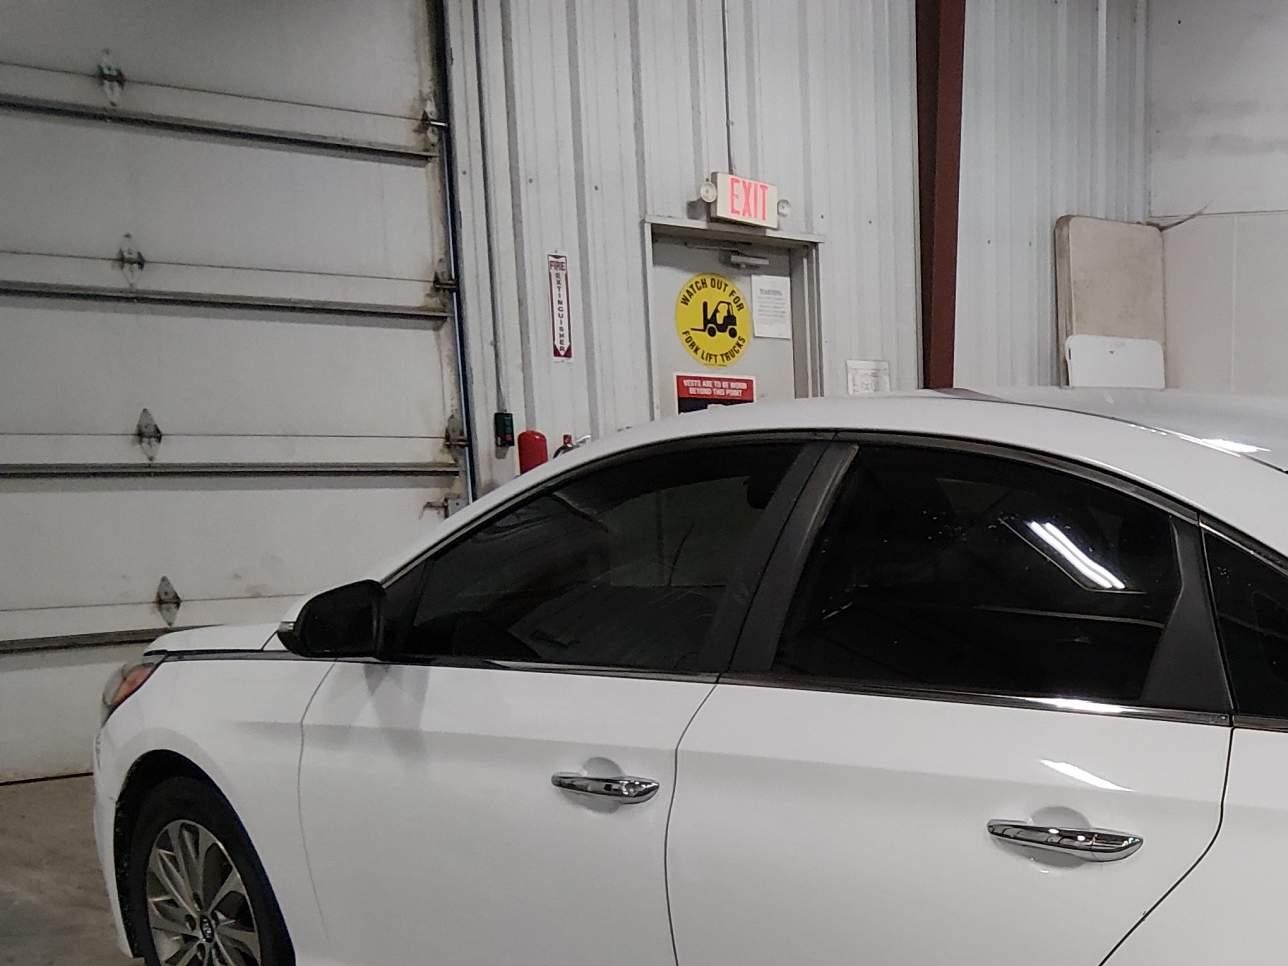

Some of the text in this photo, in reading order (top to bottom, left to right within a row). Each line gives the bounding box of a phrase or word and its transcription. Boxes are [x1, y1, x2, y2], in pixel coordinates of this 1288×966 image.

[729, 177, 769, 222] EXIT
[549, 260, 566, 271] FIRE
[555, 272, 565, 352] EXTINGUISHER
[681, 278, 708, 306] WATCH
[710, 278, 728, 292] OUT
[728, 289, 745, 312] FOR
[682, 330, 746, 365] FORK LIFT TRUCKS
[689, 387, 712, 395] BEYOND
